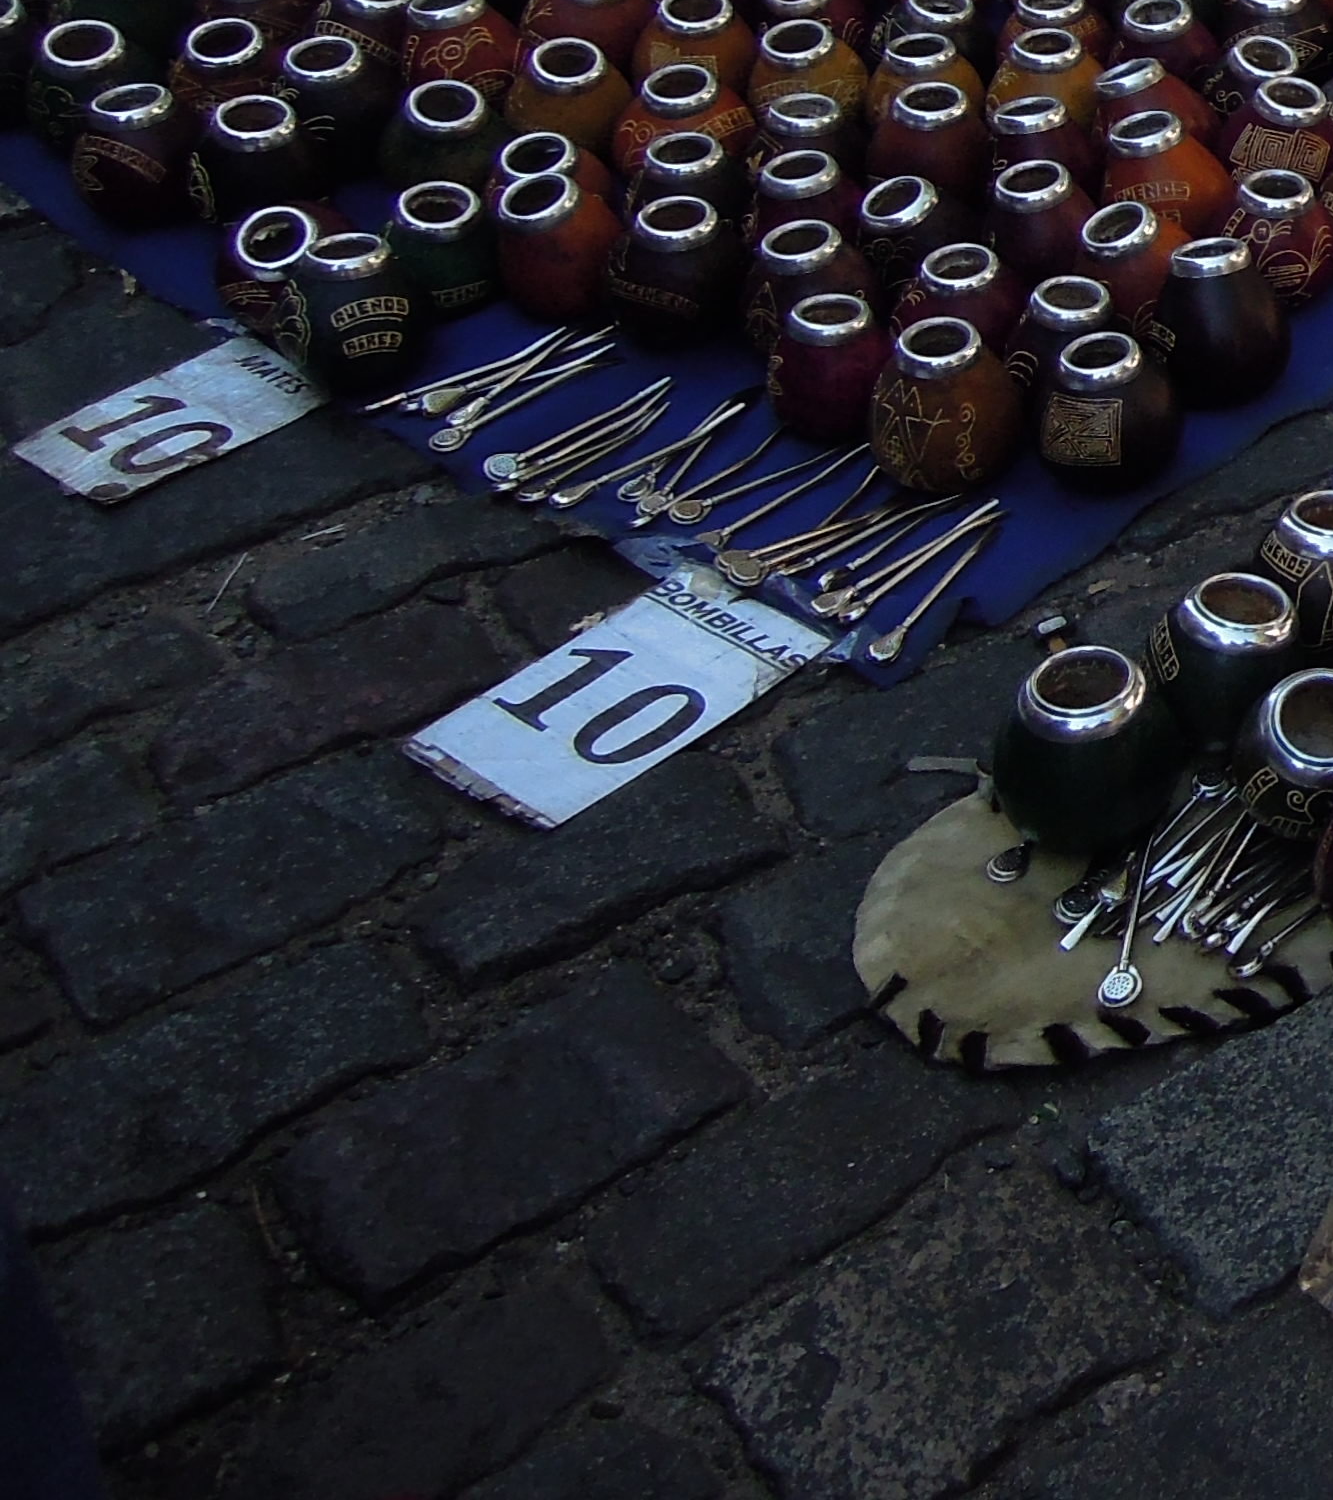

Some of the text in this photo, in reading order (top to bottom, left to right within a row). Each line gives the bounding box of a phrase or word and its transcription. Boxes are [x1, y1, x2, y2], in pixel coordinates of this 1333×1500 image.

[58, 395, 234, 474] 10
[651, 579, 808, 668] BOMBILLAS
[492, 648, 707, 764] 10
